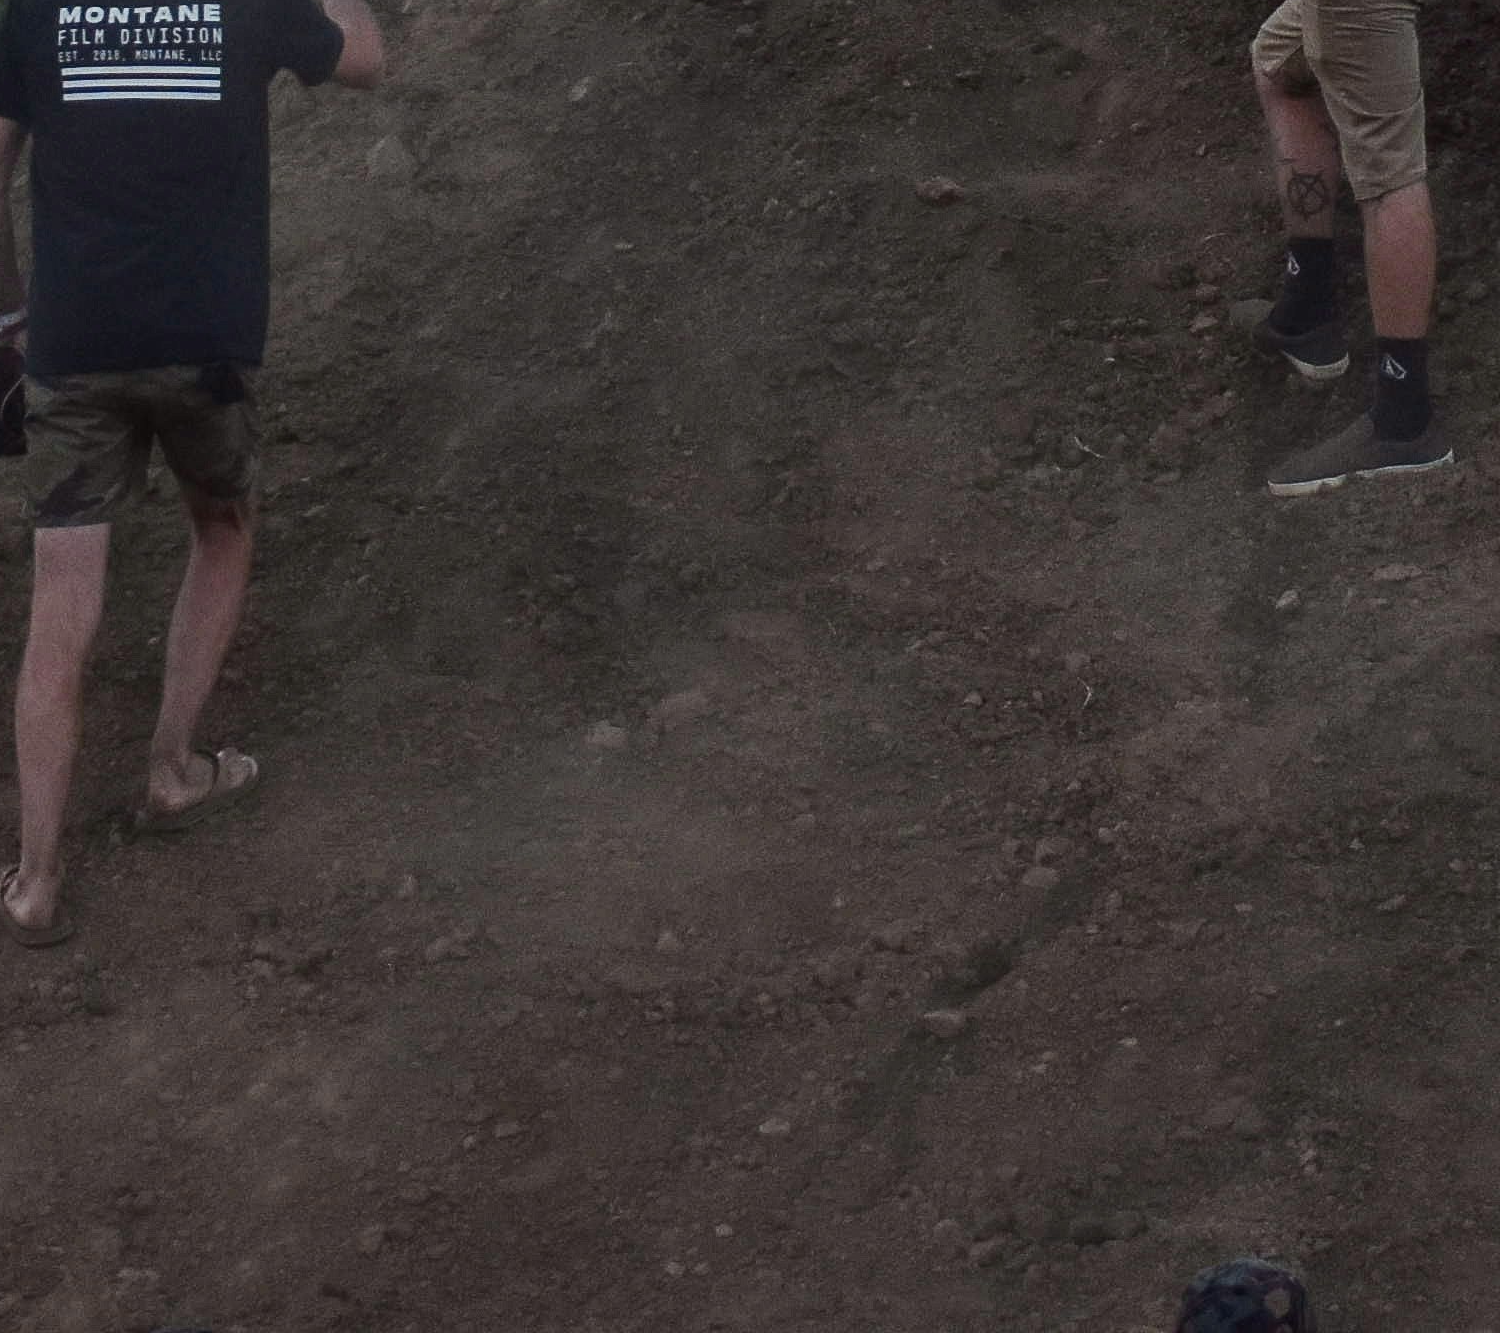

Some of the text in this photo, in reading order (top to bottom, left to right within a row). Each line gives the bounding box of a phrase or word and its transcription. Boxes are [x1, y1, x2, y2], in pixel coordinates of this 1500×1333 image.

[58, 3, 221, 25] MONTANE
[57, 27, 223, 46] FILM DIVISION
[201, 50, 223, 61] LLC
